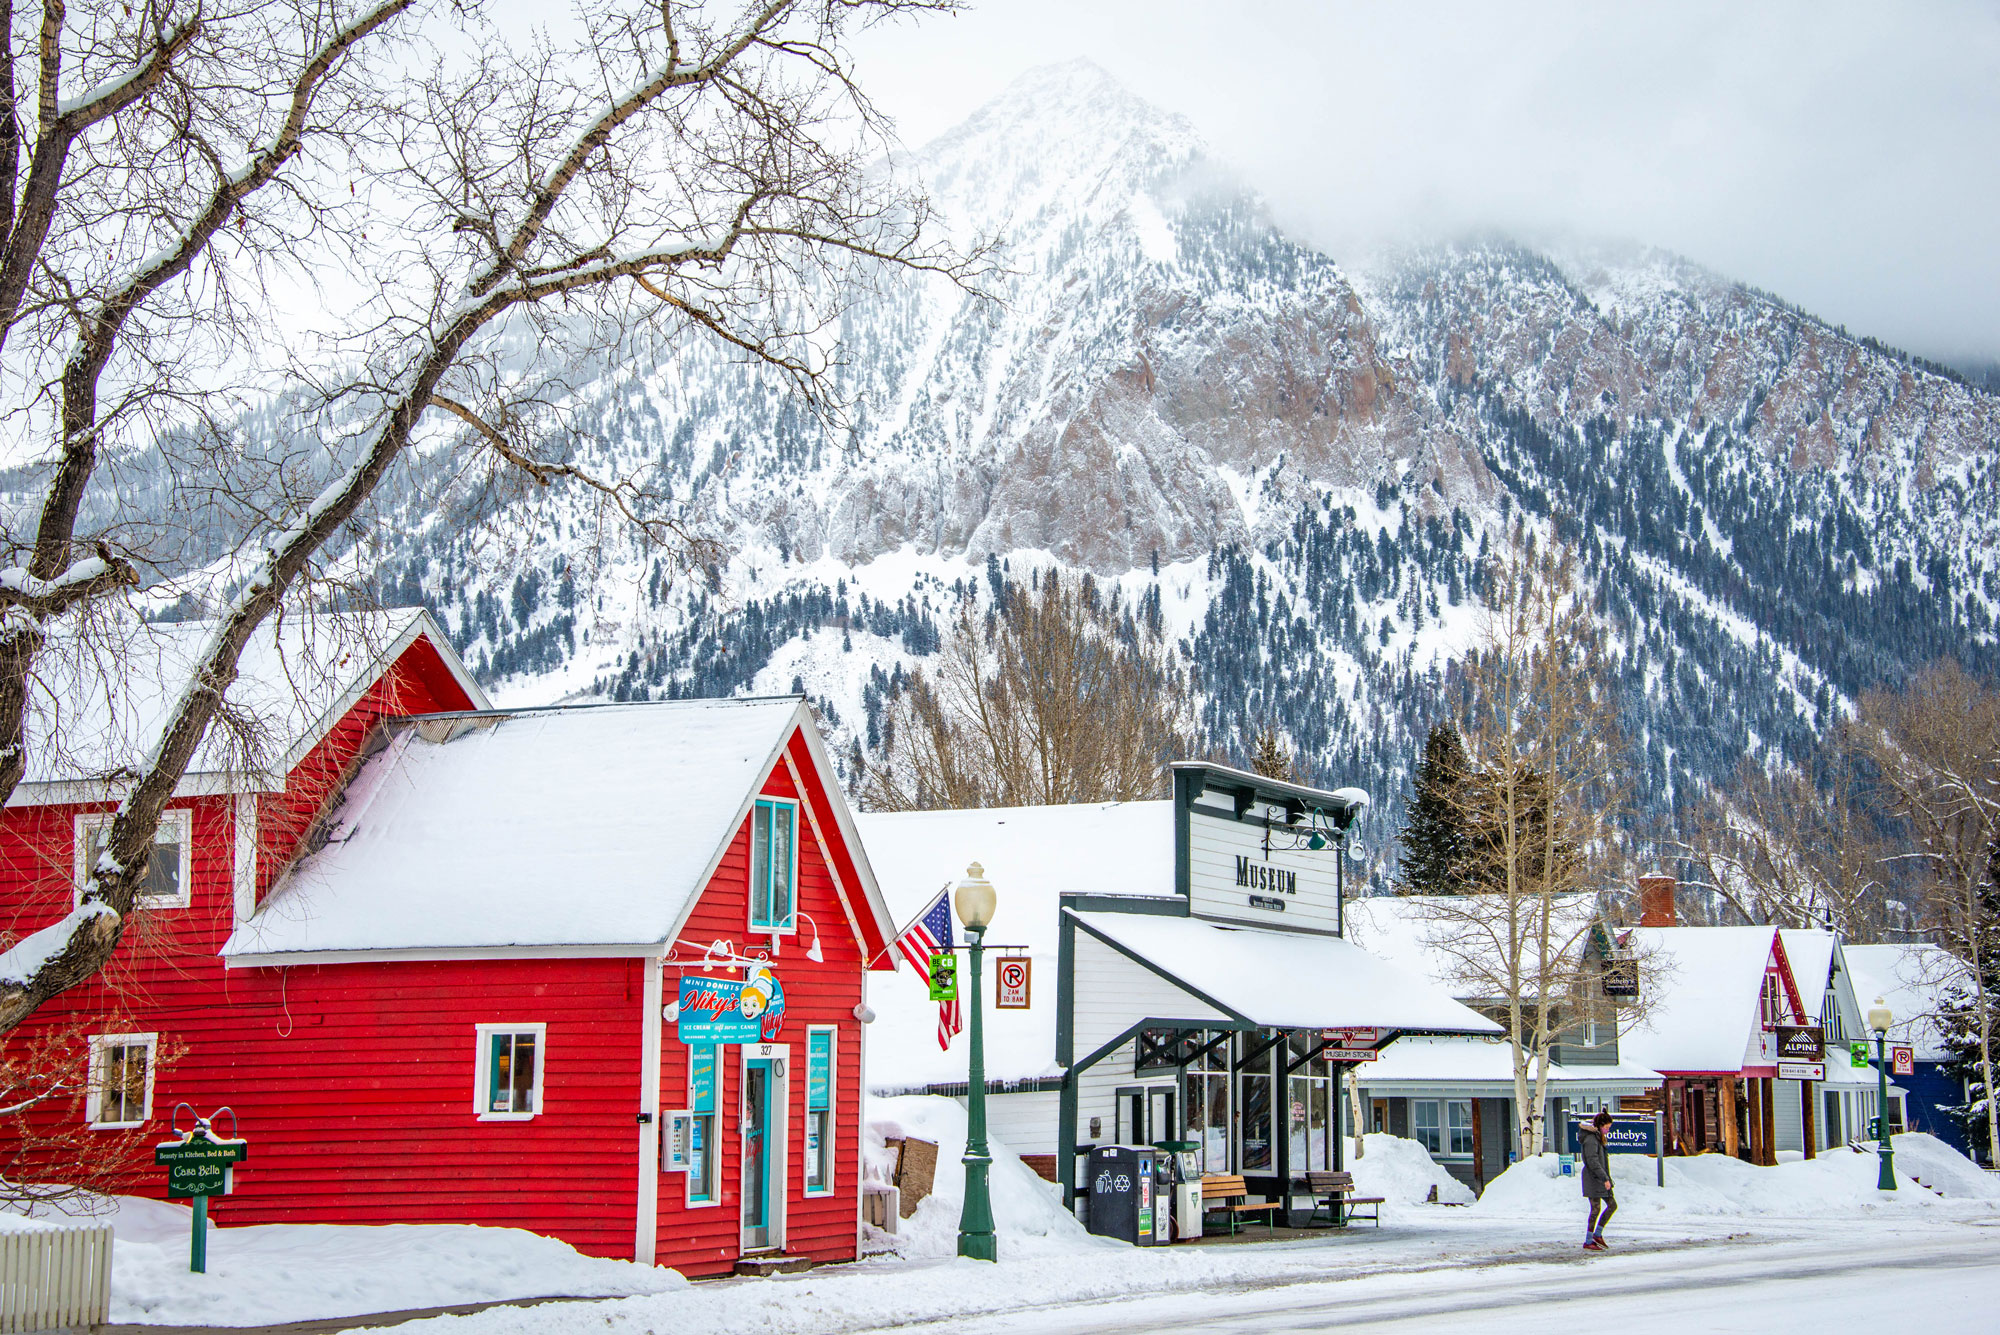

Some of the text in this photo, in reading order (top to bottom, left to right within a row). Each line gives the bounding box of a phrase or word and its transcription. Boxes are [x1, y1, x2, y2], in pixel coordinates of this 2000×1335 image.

[1236, 855, 1296, 894] MUSEUM
[941, 958, 953, 967] CB
[685, 978, 740, 992] MINI DONUTS
[1003, 995, 1010, 1003] TO
[680, 989, 740, 1022] Niky's
[760, 1045, 772, 1056] 327
[1784, 1043, 1818, 1052] ALPINE
[160, 1152, 177, 1160] Beauty
[184, 1151, 206, 1159] Kitchen,
[174, 1164, 220, 1178] Casa Bella
